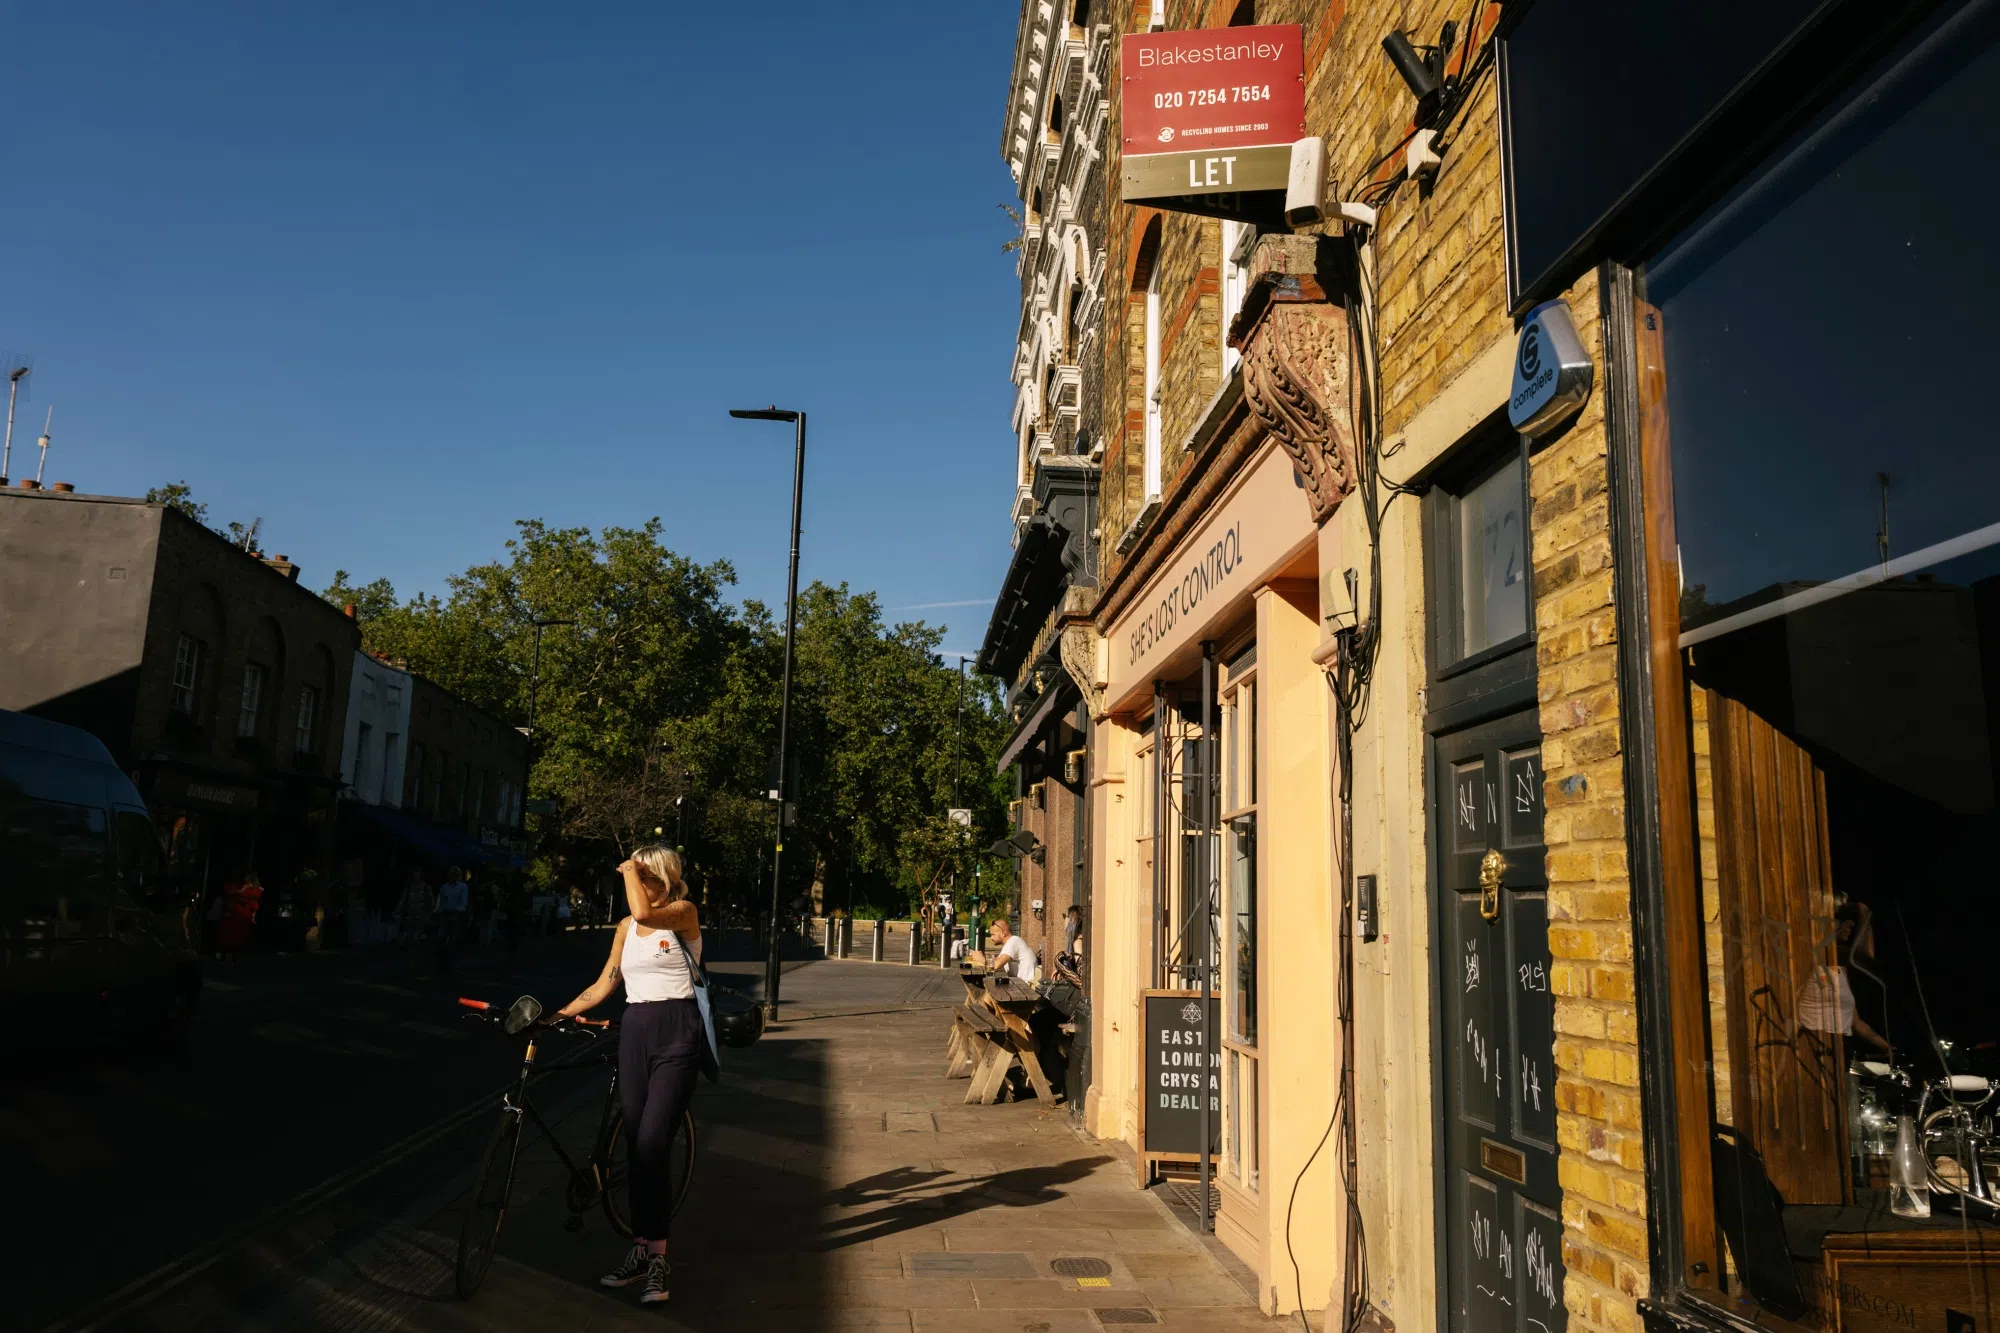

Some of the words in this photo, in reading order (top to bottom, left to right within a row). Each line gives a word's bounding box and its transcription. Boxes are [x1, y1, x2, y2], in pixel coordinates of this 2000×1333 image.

[1138, 40, 1284, 67] Blakestanley
[1154, 92, 1183, 109] 020
[1188, 88, 1227, 107] 7254
[1231, 85, 1271, 103] 7554
[1181, 126, 1212, 137] RECYCLING
[1213, 125, 1234, 135] HOMES
[1234, 123, 1252, 133] SINCE
[1253, 123, 1269, 131] 2003
[1189, 156, 1237, 188] LET
[1513, 368, 1553, 410] complete
[1130, 613, 1153, 667] SHE'S
[1155, 585, 1179, 643] LOST
[1181, 520, 1243, 616] CONTROL
[1161, 1029, 1202, 1046] EAST
[1160, 1072, 1219, 1090] CRYSA
[1160, 1093, 1219, 1112] DEALR
